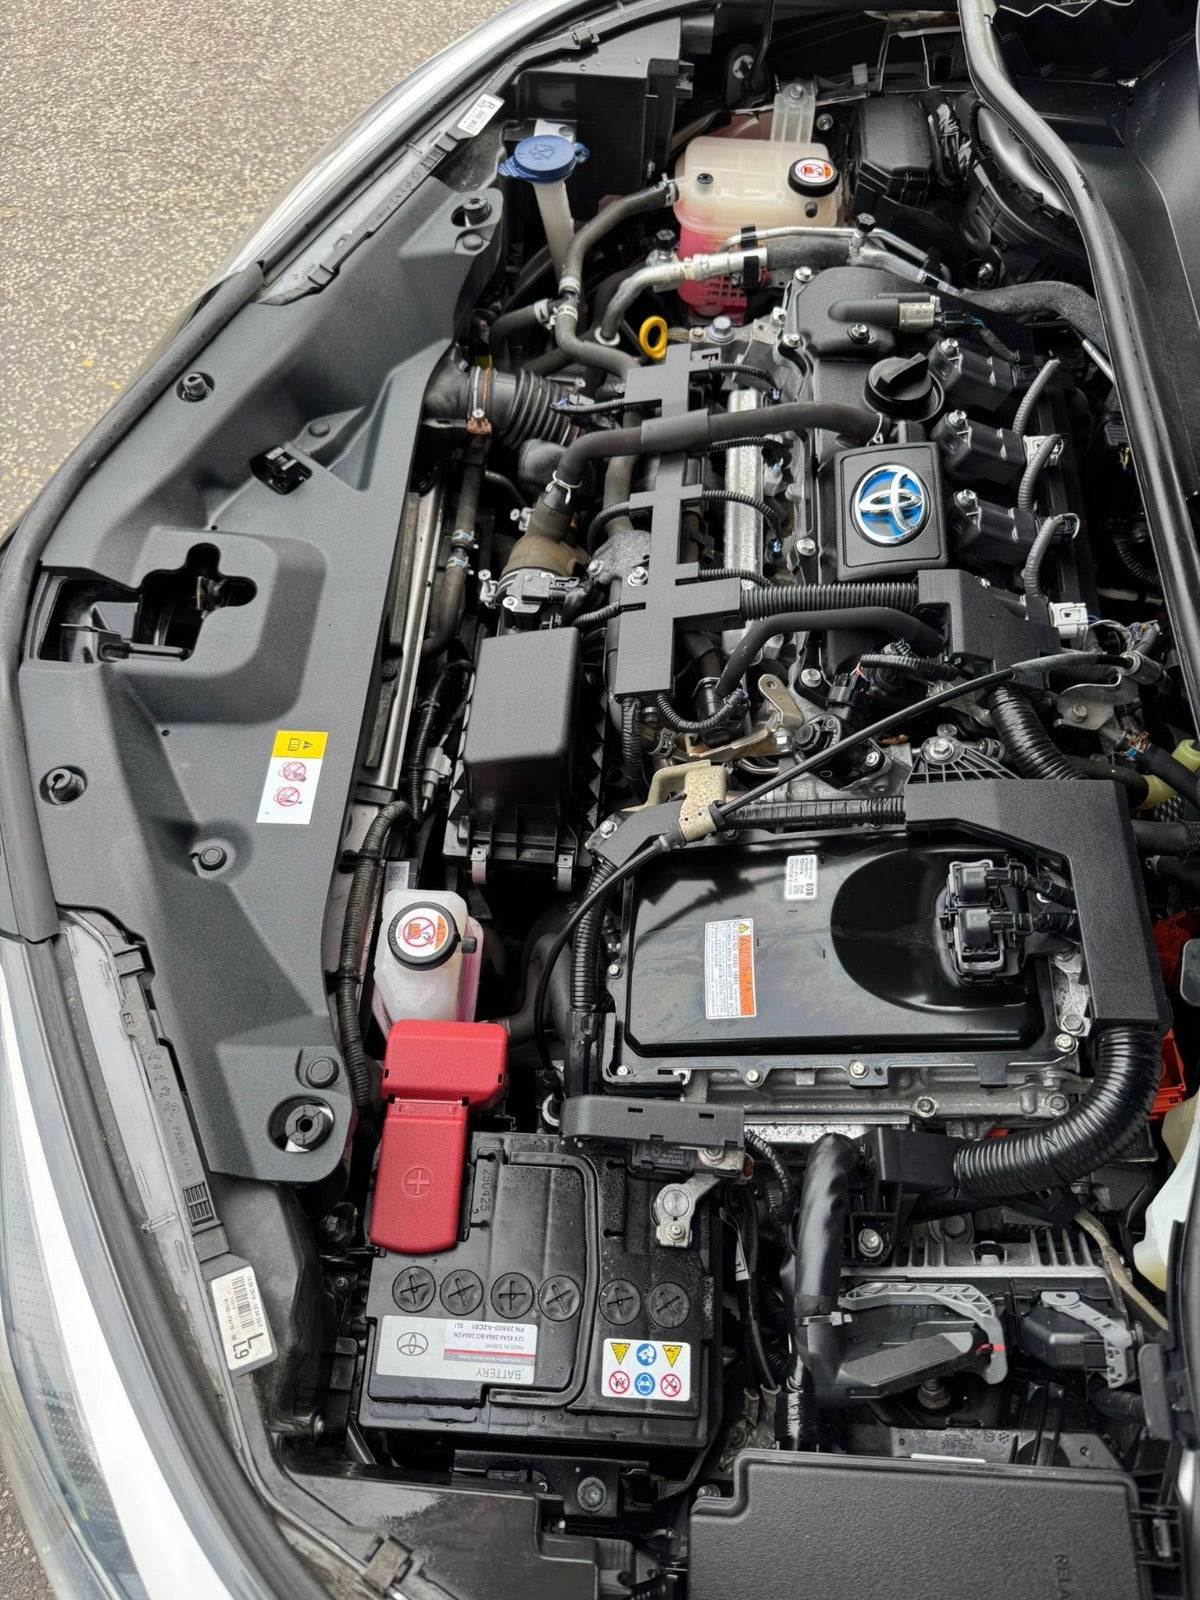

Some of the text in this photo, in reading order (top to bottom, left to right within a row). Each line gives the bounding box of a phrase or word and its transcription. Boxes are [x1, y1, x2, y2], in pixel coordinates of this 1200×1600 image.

[247, 1332, 264, 1349] L
[232, 1340, 250, 1360] L9
[475, 1367, 522, 1380] BATTERY
